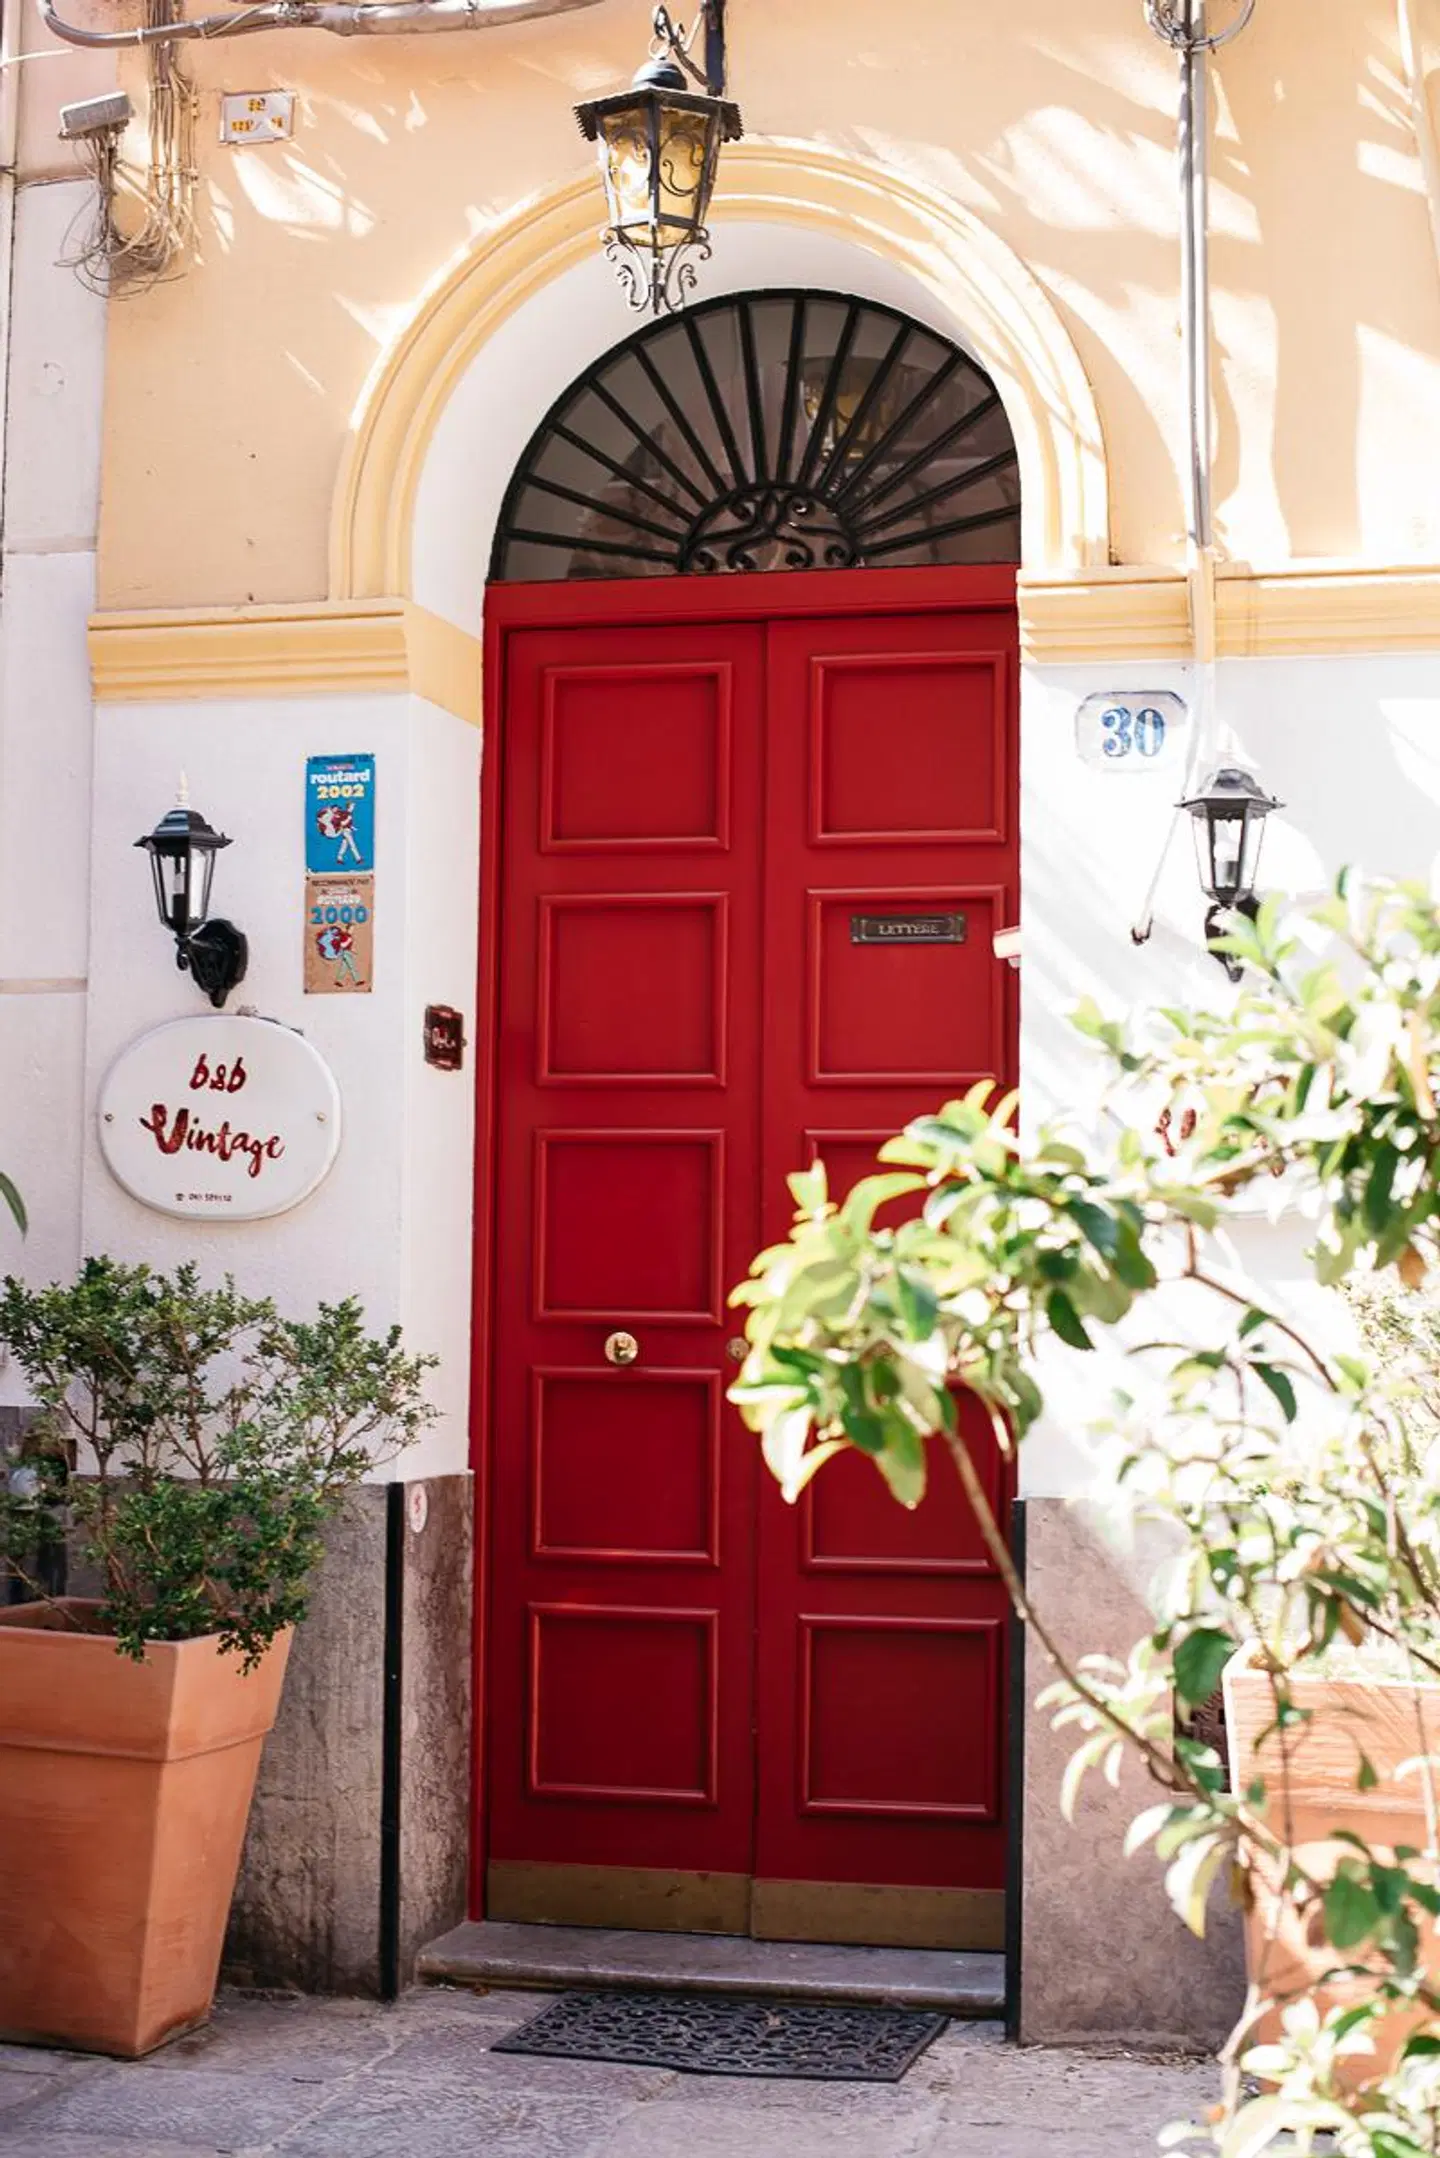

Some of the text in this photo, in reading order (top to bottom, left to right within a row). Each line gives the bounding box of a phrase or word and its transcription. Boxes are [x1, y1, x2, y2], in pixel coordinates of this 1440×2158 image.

[1101, 707, 1165, 757] 30
[310, 769, 370, 784] routard
[317, 784, 365, 800] 2002
[310, 905, 369, 924] 2000
[139, 1103, 285, 1178] Vintage
